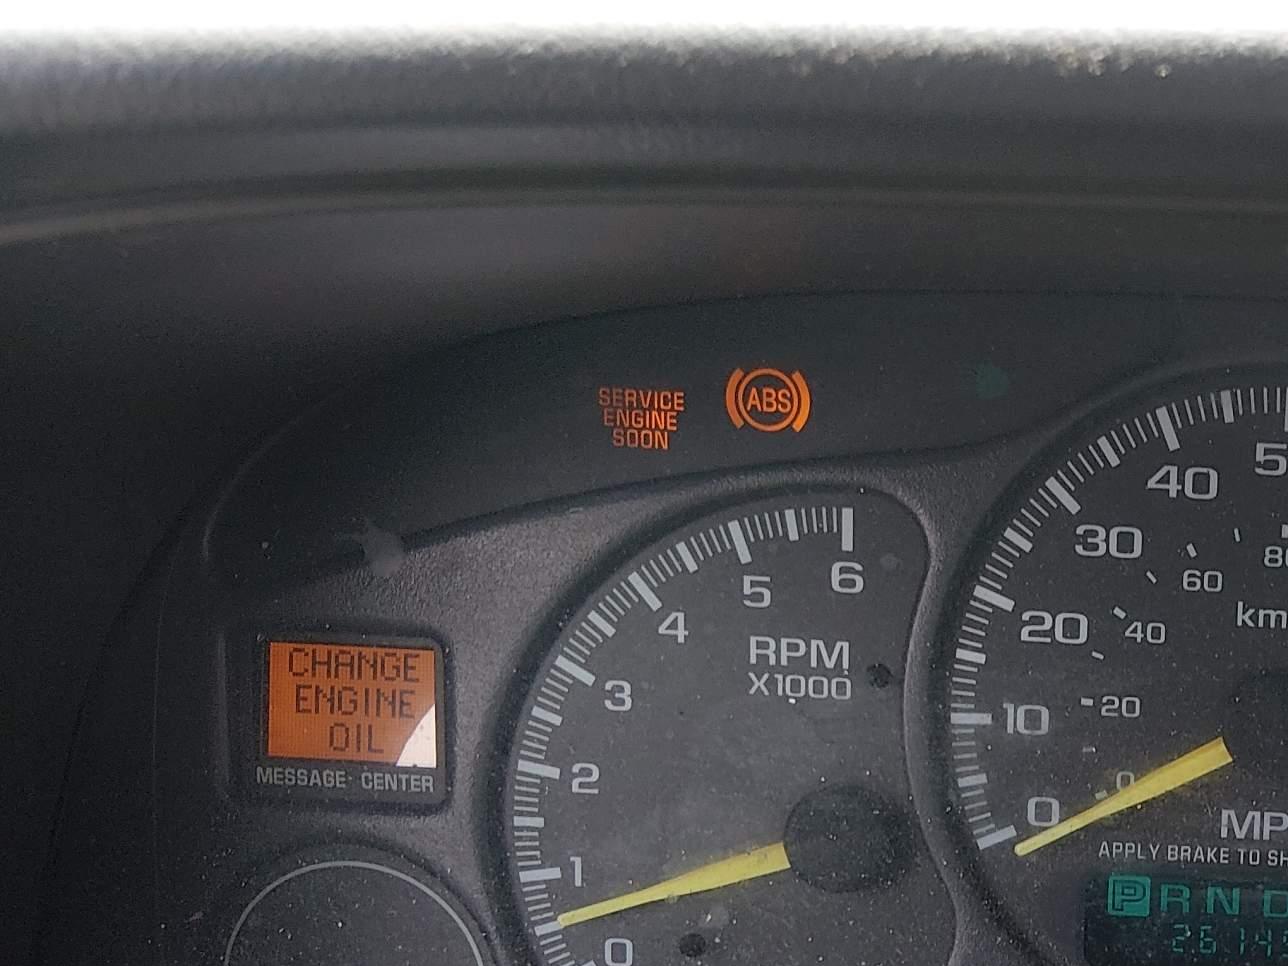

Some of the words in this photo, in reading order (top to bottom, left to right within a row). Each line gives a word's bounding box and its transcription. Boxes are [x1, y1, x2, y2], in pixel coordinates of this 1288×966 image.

[599, 387, 685, 411] SERVICE
[747, 387, 792, 413] ABS
[603, 409, 678, 431] ENGINE
[612, 429, 669, 450] SOON
[1147, 466, 1219, 500] 40
[1075, 525, 1143, 560] 30
[743, 576, 772, 608] 5
[830, 561, 865, 594] 6
[1182, 570, 1223, 592] 60
[658, 612, 689, 643] 4
[1020, 611, 1088, 645] 20
[1124, 620, 1166, 644] 40
[288, 648, 420, 682] CHANGE
[748, 635, 850, 669] RPM
[295, 684, 416, 718] ENGINE
[603, 680, 633, 711] 3
[748, 672, 853, 700] X1000
[1003, 702, 1049, 735] 10
[1101, 696, 1141, 718] 20
[329, 723, 385, 753] OIL
[256, 767, 346, 788] MESSAGE
[361, 772, 434, 792] CENTER
[572, 763, 600, 794] 2
[1027, 796, 1060, 827] 0
[1098, 840, 1160, 861] APPLY
[1166, 844, 1229, 865] BRAKE
[1237, 848, 1260, 866] TO
[569, 857, 583, 888] 1
[1112, 879, 1147, 912] P
[1160, 884, 1192, 913] R
[1206, 887, 1241, 916] N
